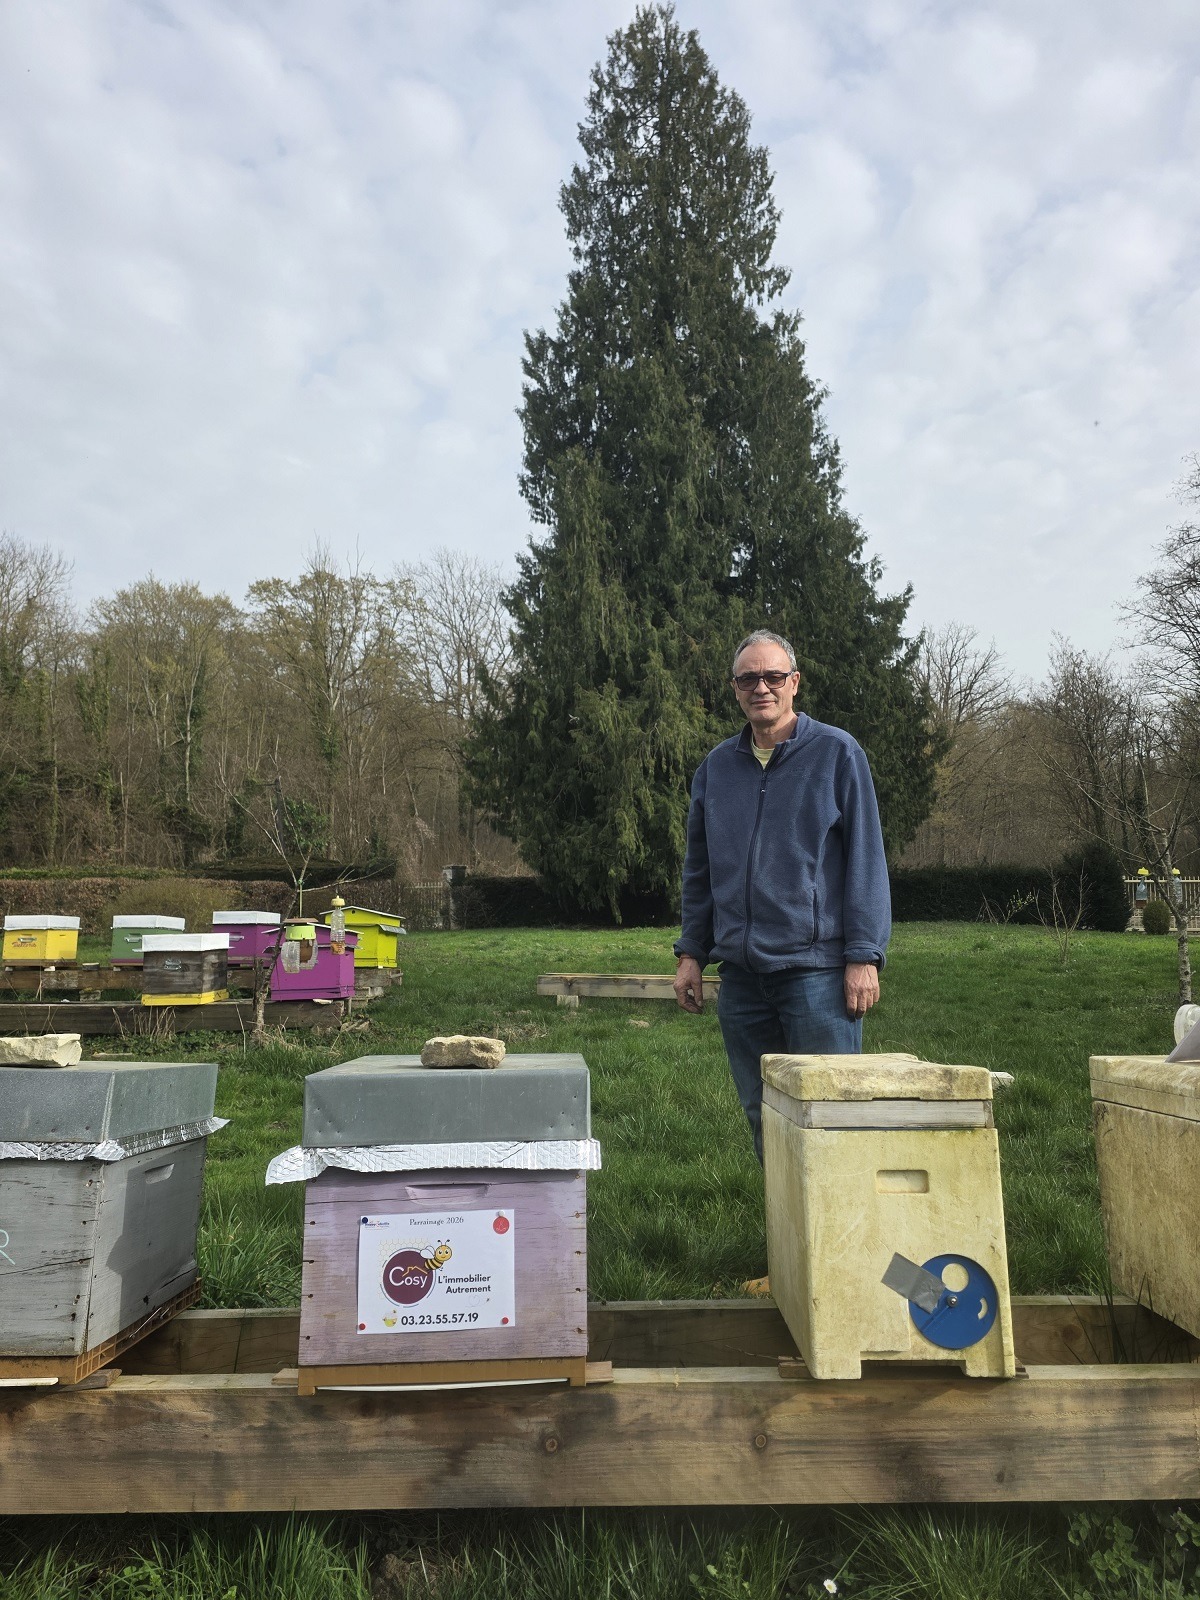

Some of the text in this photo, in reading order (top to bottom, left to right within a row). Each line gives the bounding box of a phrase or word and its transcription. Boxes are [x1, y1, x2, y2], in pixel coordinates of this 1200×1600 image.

[409, 1216, 464, 1226] Parrainage 2026
[389, 1266, 428, 1288] Cosy
[437, 1274, 491, 1284] L'immobilier
[445, 1285, 491, 1294] Autrement
[401, 1312, 479, 1326] 03.23.55.57.19
